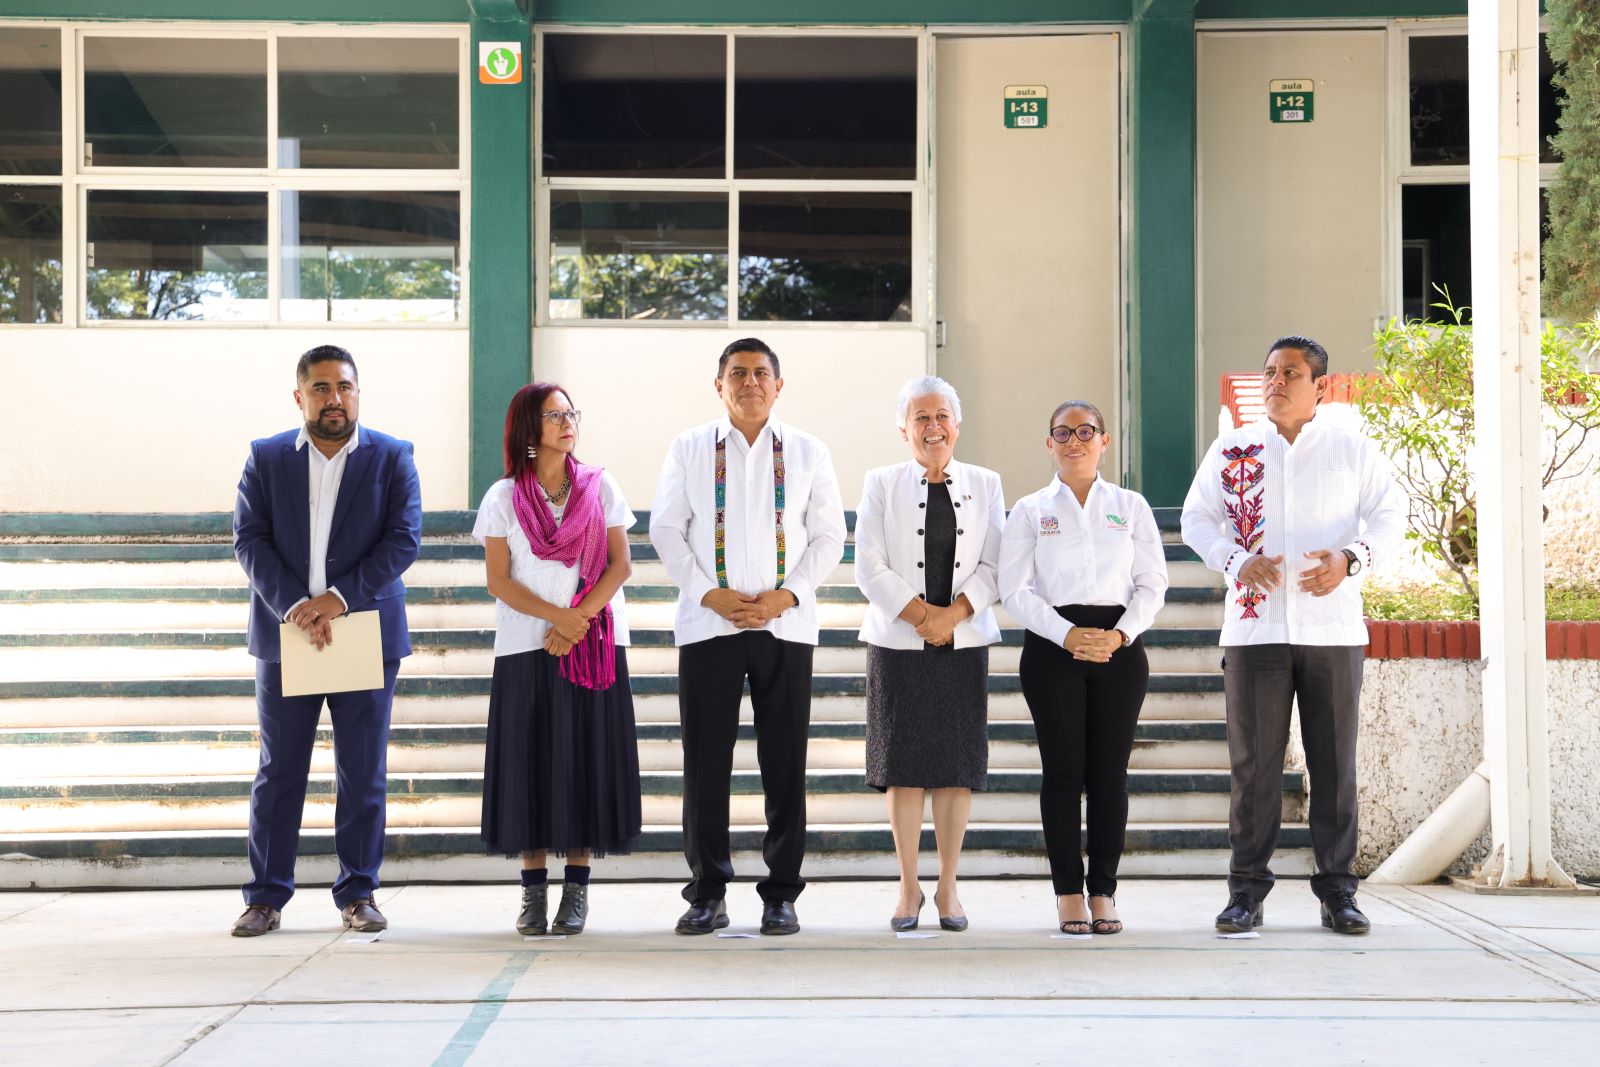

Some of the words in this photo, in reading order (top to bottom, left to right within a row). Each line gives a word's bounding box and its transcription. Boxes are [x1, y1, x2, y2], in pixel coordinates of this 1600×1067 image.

[1276, 96, 1304, 107] I-12
[1011, 102, 1038, 113] I-13
[1286, 111, 1299, 119] 301
